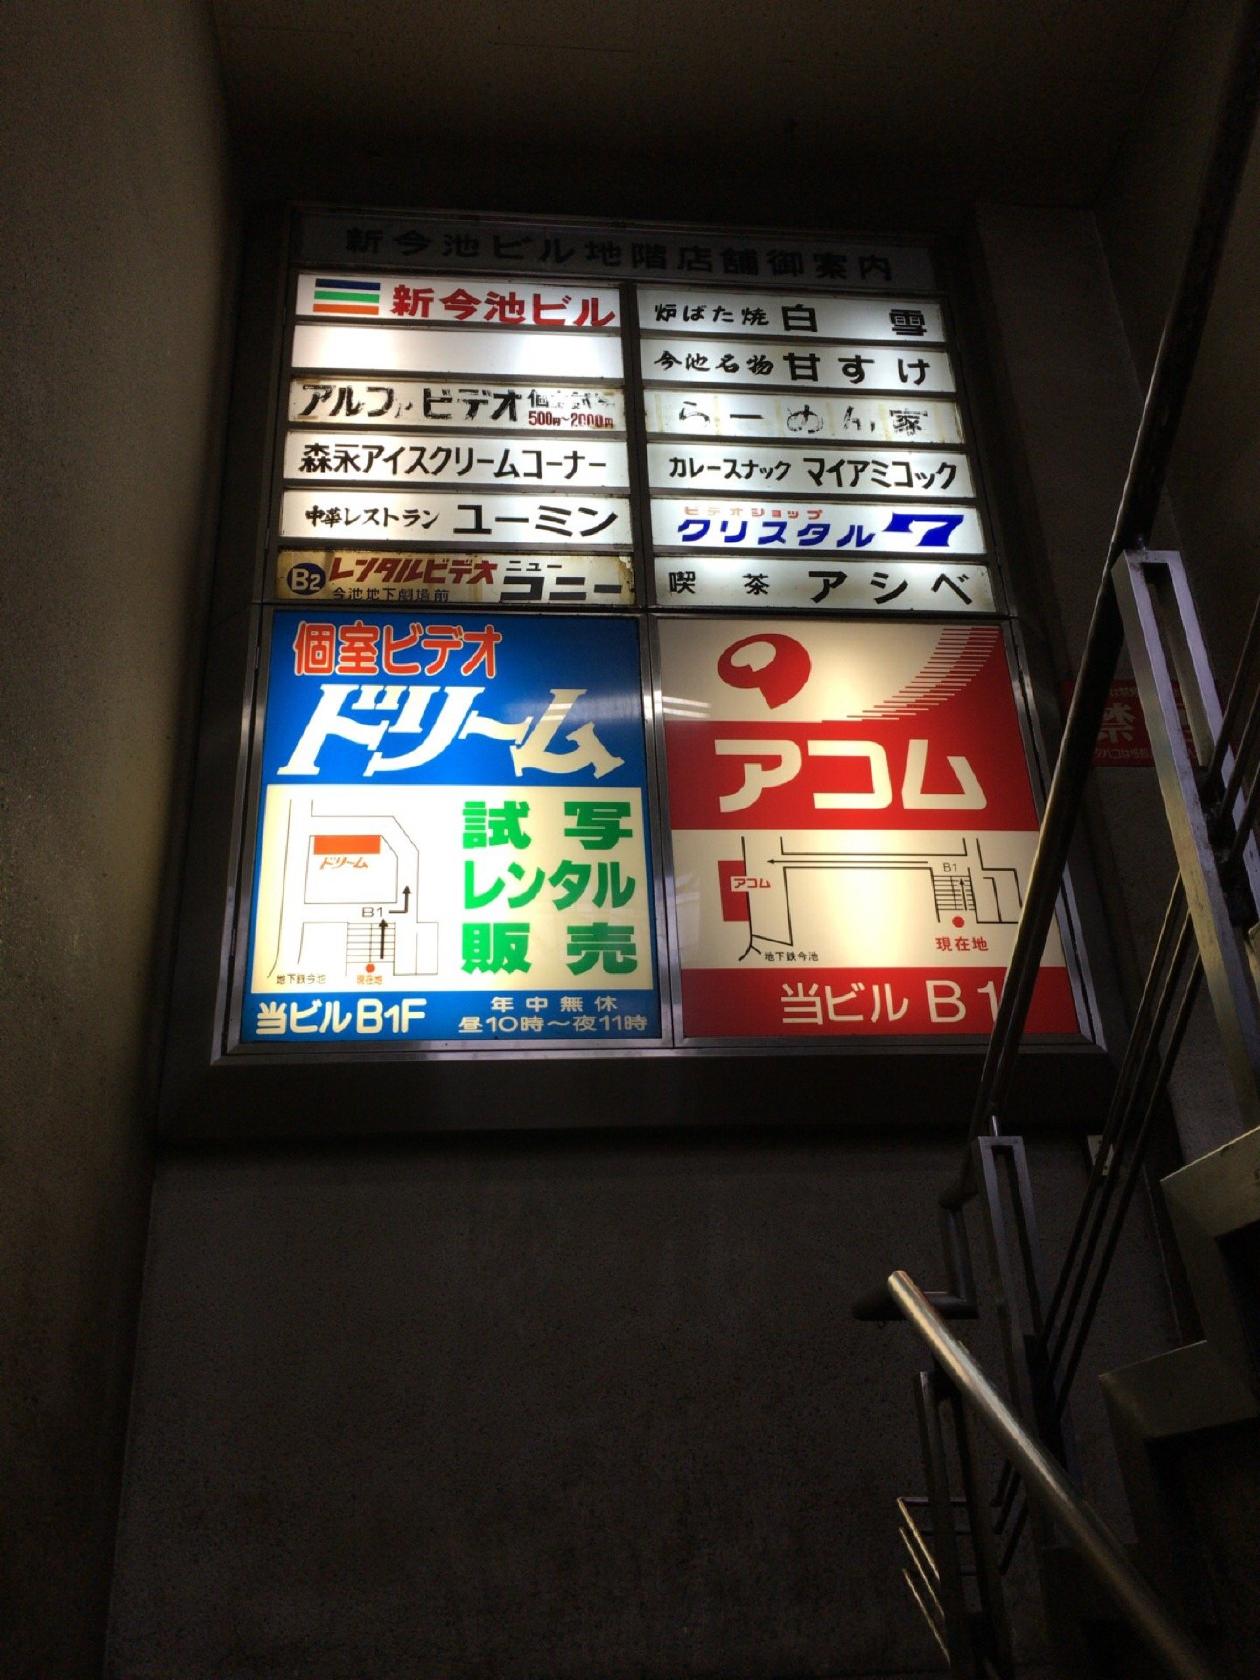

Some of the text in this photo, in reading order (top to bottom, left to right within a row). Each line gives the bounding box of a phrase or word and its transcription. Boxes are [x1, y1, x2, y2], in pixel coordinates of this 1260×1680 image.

[346, 227, 892, 282] 新今池ビル地階店舗御案内
[390, 284, 616, 328] 新今池ビル
[654, 303, 769, 326] 炉ばた焼
[653, 350, 930, 385] 今池名物 甘すけ
[299, 443, 607, 480] 森永アイスクリームコーナー
[669, 456, 957, 490] カレースナック マイアミコック
[306, 504, 618, 537] 中華レストラン ユーミン
[684, 506, 823, 520] ビデオショップ
[677, 518, 876, 548] クリスタル
[291, 568, 321, 591] B2
[329, 557, 498, 584] レンタルビデオ
[507, 561, 563, 572] ニュー
[333, 587, 450, 602] 今池地下劇場前
[500, 576, 623, 601] コニー
[808, 570, 973, 606] アシベ
[293, 620, 502, 679] 個室ビデオ
[276, 684, 625, 779] ドリーム
[714, 739, 988, 813] アコム
[462, 801, 633, 851] 試写
[320, 856, 369, 870] ドリーム
[943, 862, 957, 872] B1
[464, 860, 636, 911] レンタル
[733, 877, 771, 890] アコム
[362, 907, 383, 918] B1
[461, 922, 638, 976] 販売
[935, 936, 989, 951] 現在地
[490, 996, 618, 1012] 年中無休
